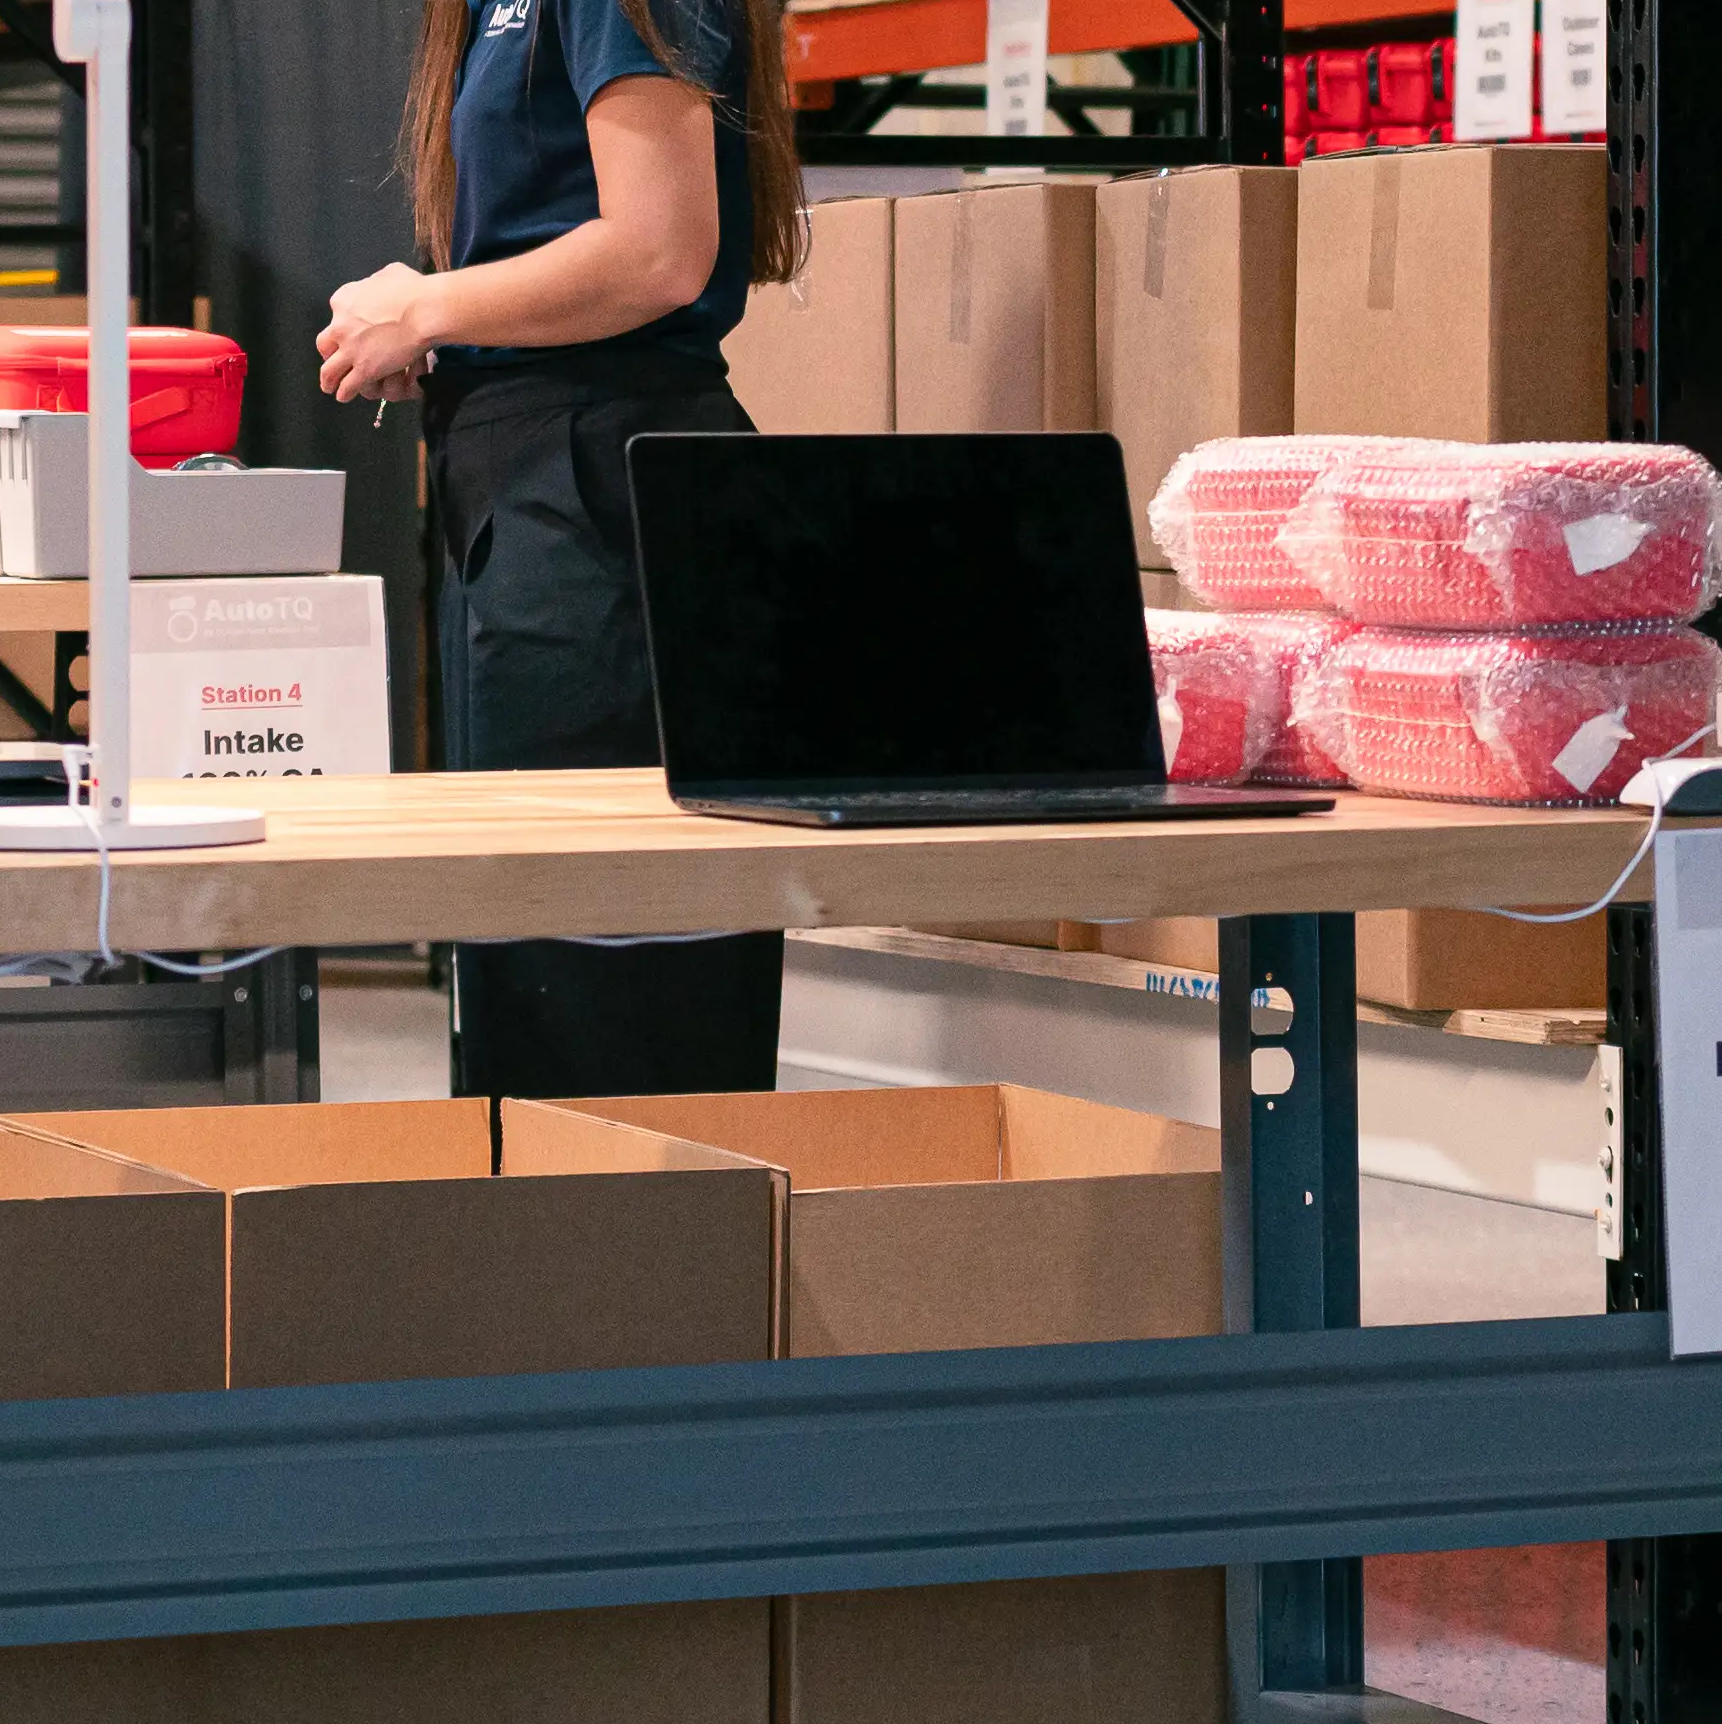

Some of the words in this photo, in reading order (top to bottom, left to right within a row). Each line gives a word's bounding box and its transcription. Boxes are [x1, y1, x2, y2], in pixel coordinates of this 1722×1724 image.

[203, 595, 314, 622] AutoTQ
[201, 685, 282, 705] Station
[287, 682, 303, 701] 4
[204, 727, 305, 756] Intake
